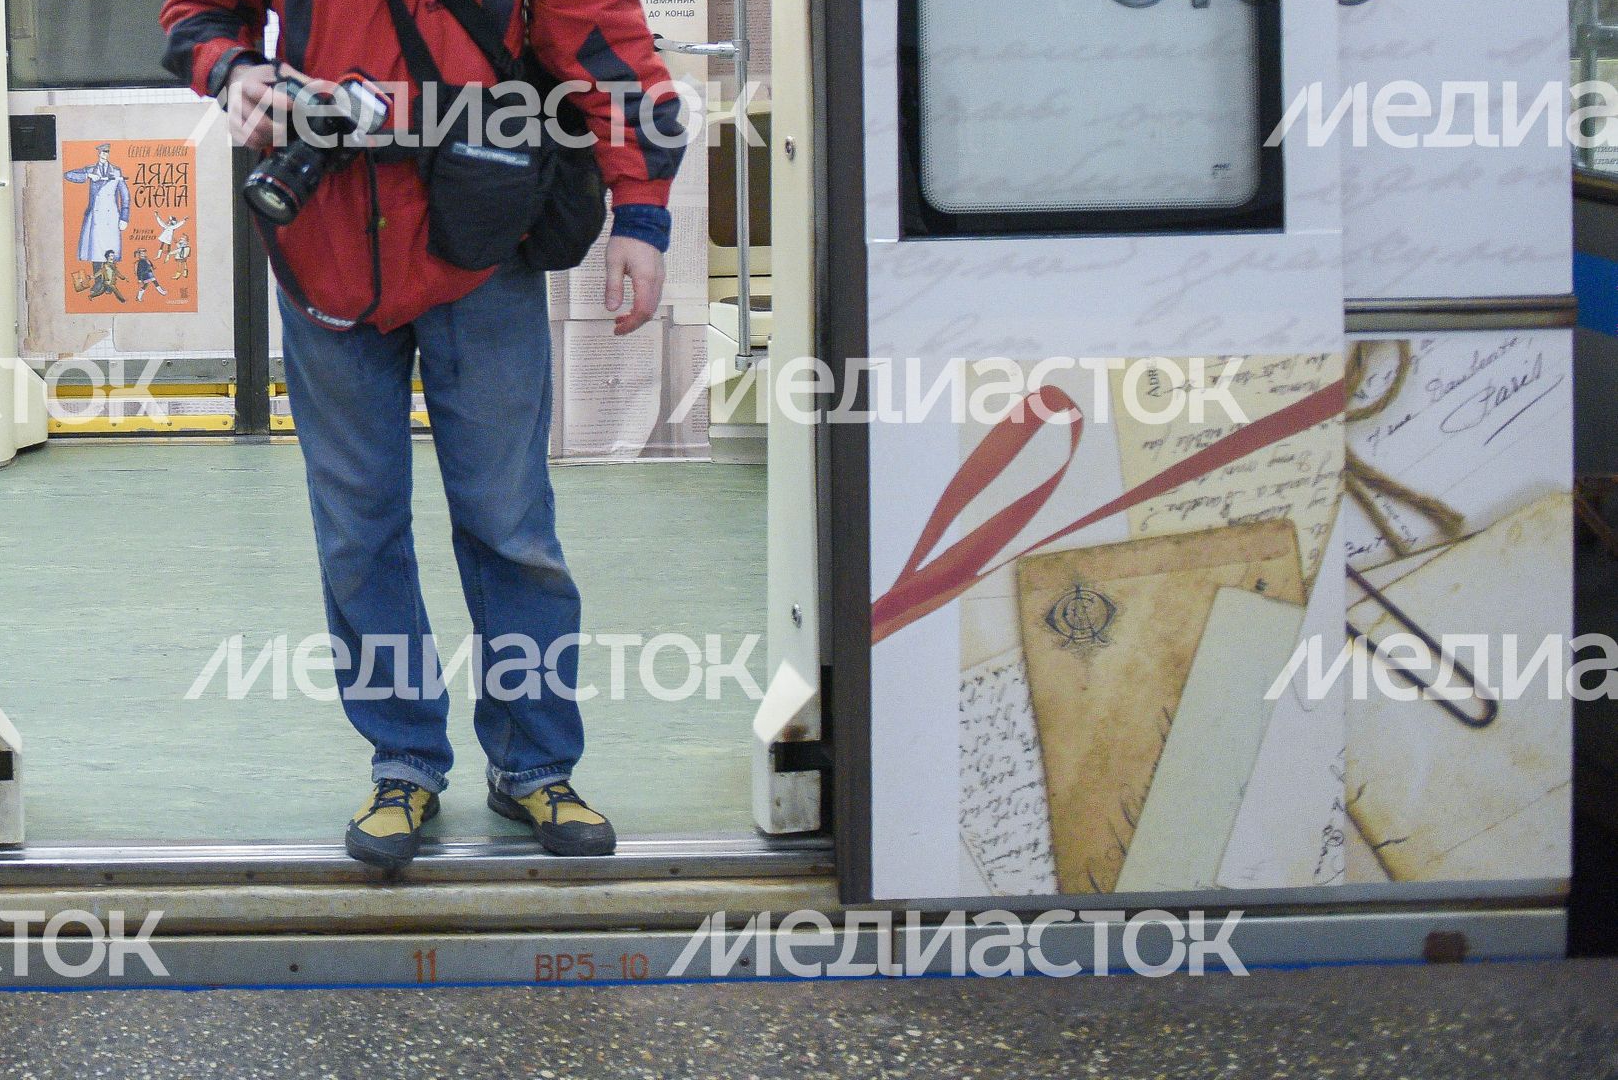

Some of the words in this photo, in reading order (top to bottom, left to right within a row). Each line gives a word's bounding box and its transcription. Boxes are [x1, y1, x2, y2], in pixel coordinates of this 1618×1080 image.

[648, 9, 661, 18] до
[665, 9, 695, 18] конца
[132, 162, 190, 186] ДЯДЯ
[133, 184, 189, 209] СТЕПА
[412, 947, 438, 984] 11
